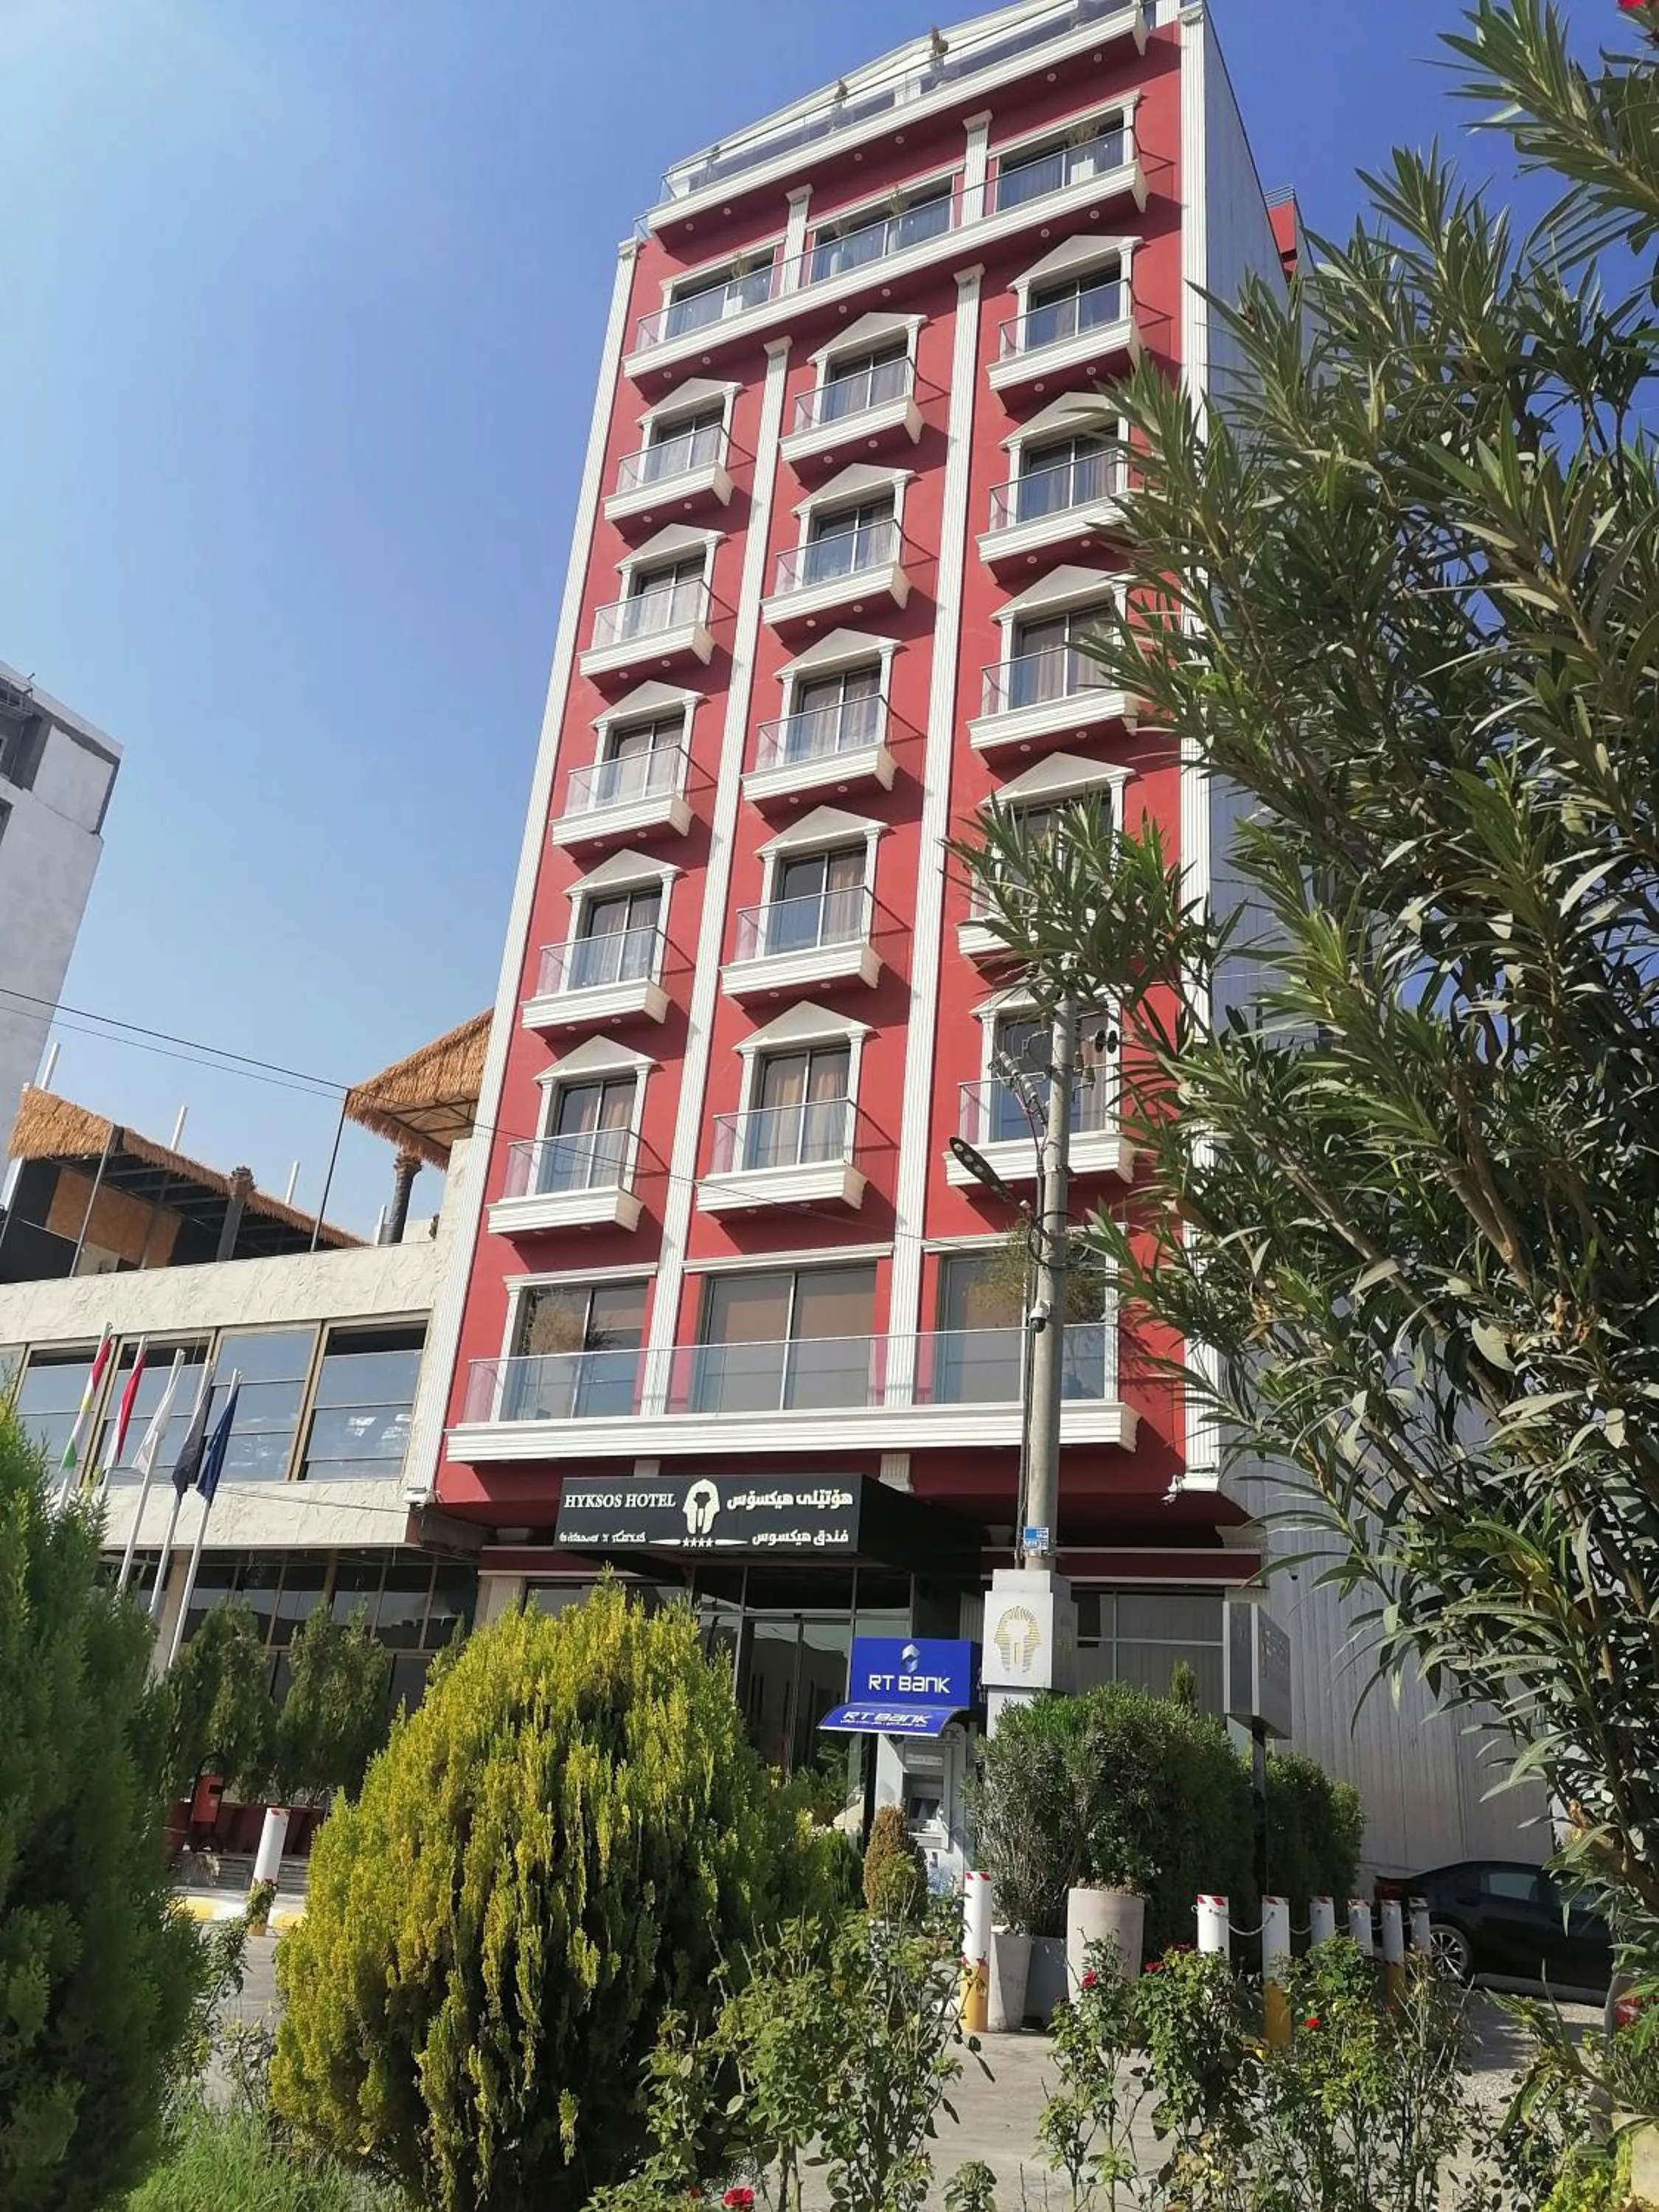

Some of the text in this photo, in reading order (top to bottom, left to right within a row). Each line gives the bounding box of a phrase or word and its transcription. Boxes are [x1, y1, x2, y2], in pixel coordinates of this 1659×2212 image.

[563, 1493, 676, 1509] HYKSOS HOTEL
[813, 1528, 849, 1546] فندق
[868, 1674, 895, 1691] RT
[843, 1711, 875, 1720] RT
